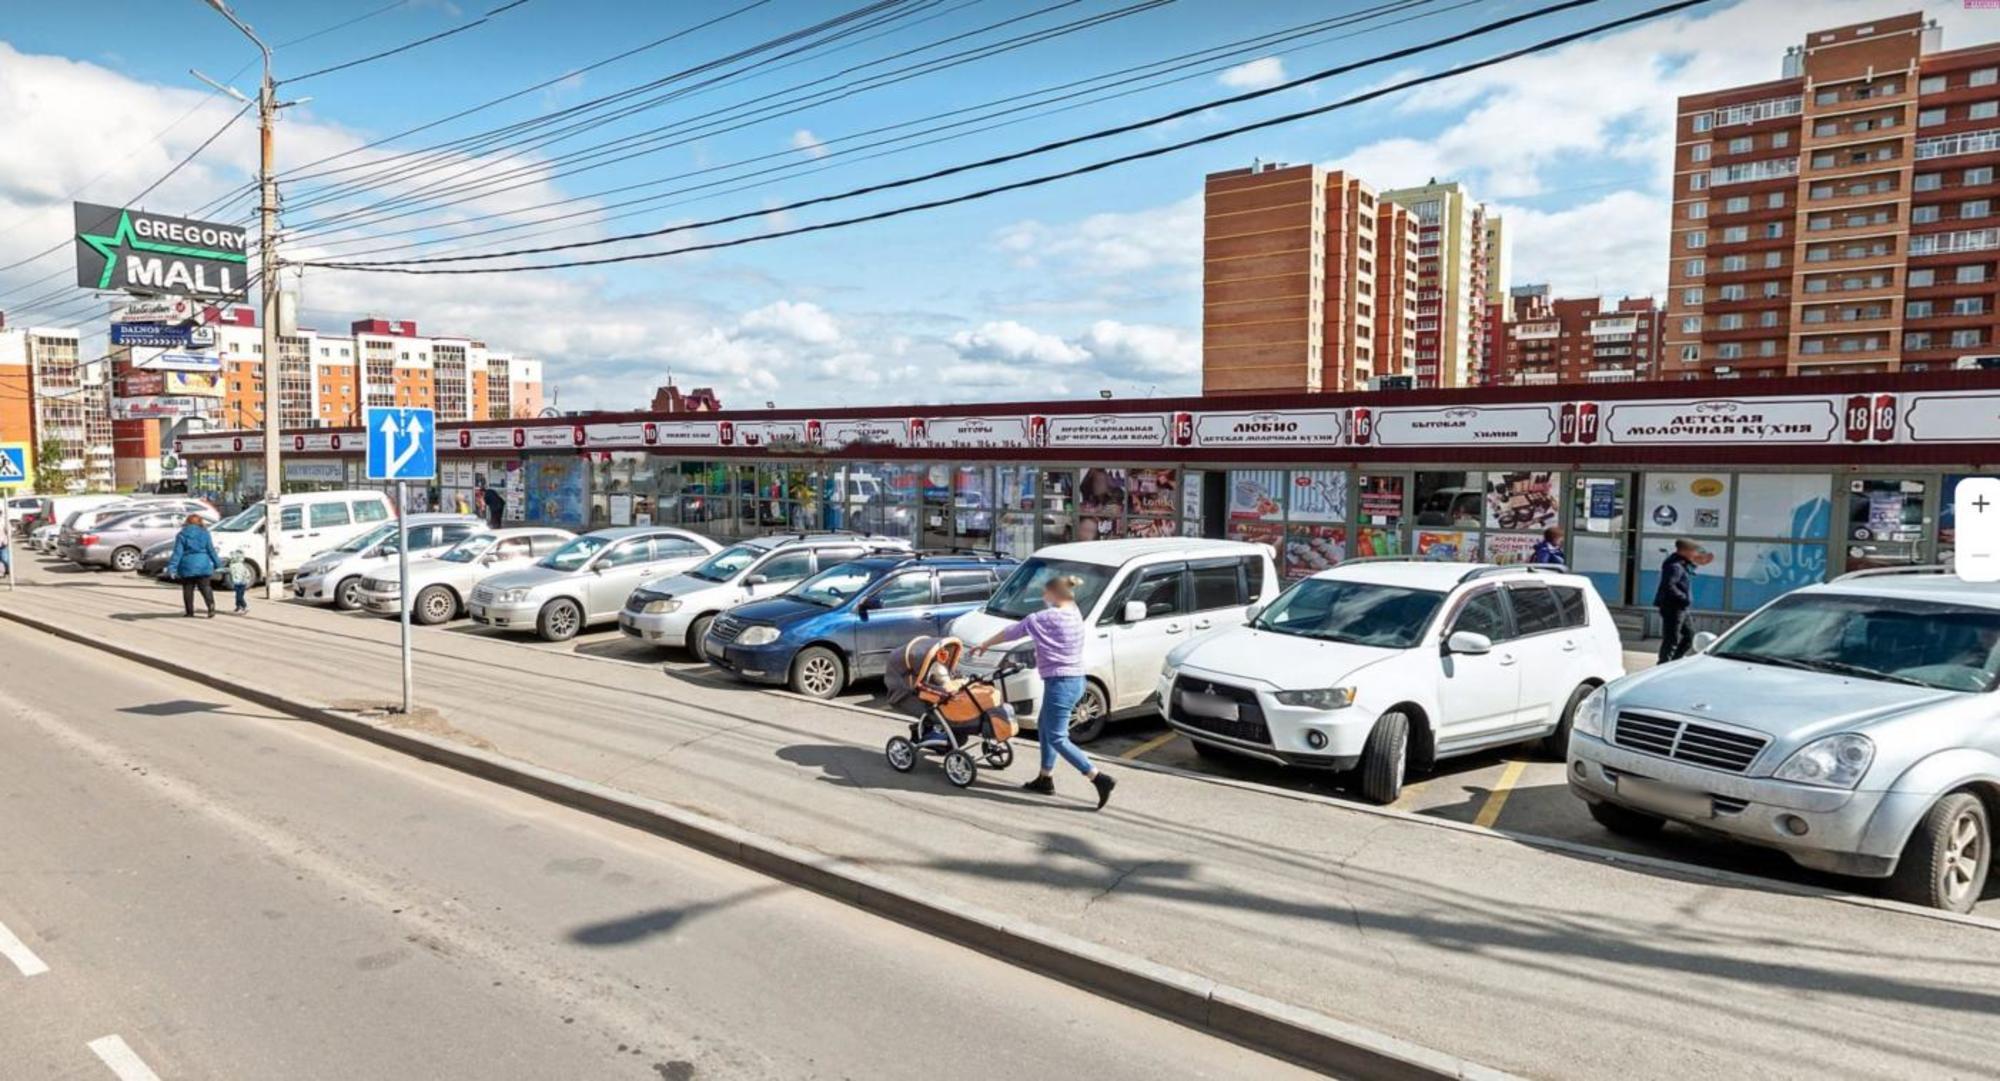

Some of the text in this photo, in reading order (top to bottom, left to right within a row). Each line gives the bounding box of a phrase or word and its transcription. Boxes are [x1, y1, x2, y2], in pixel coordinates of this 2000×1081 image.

[134, 218, 246, 250] GREGORY
[126, 255, 243, 295] MALL
[1411, 420, 1467, 428] БЫТОВАЯ
[1562, 414, 1575, 434] 17
[1581, 413, 1596, 434] 17
[1671, 414, 1764, 425] ДЕТСКАЯ
[1849, 408, 1868, 430] 18
[1876, 407, 1894, 430] 18
[645, 428, 656, 441] 10
[722, 427, 732, 440] 11
[958, 426, 993, 434] ШТОРЫ
[1178, 421, 1190, 438] 15
[1233, 422, 1298, 433] ЛЮБИО
[1356, 418, 1369, 436] 16
[1626, 424, 1812, 439] МОЛОЧНАЯ КУХНЯ
[576, 429, 583, 442] 9
[1203, 435, 1244, 443] ДЕТСКАЯ
[1300, 434, 1333, 443] КУХНЯ
